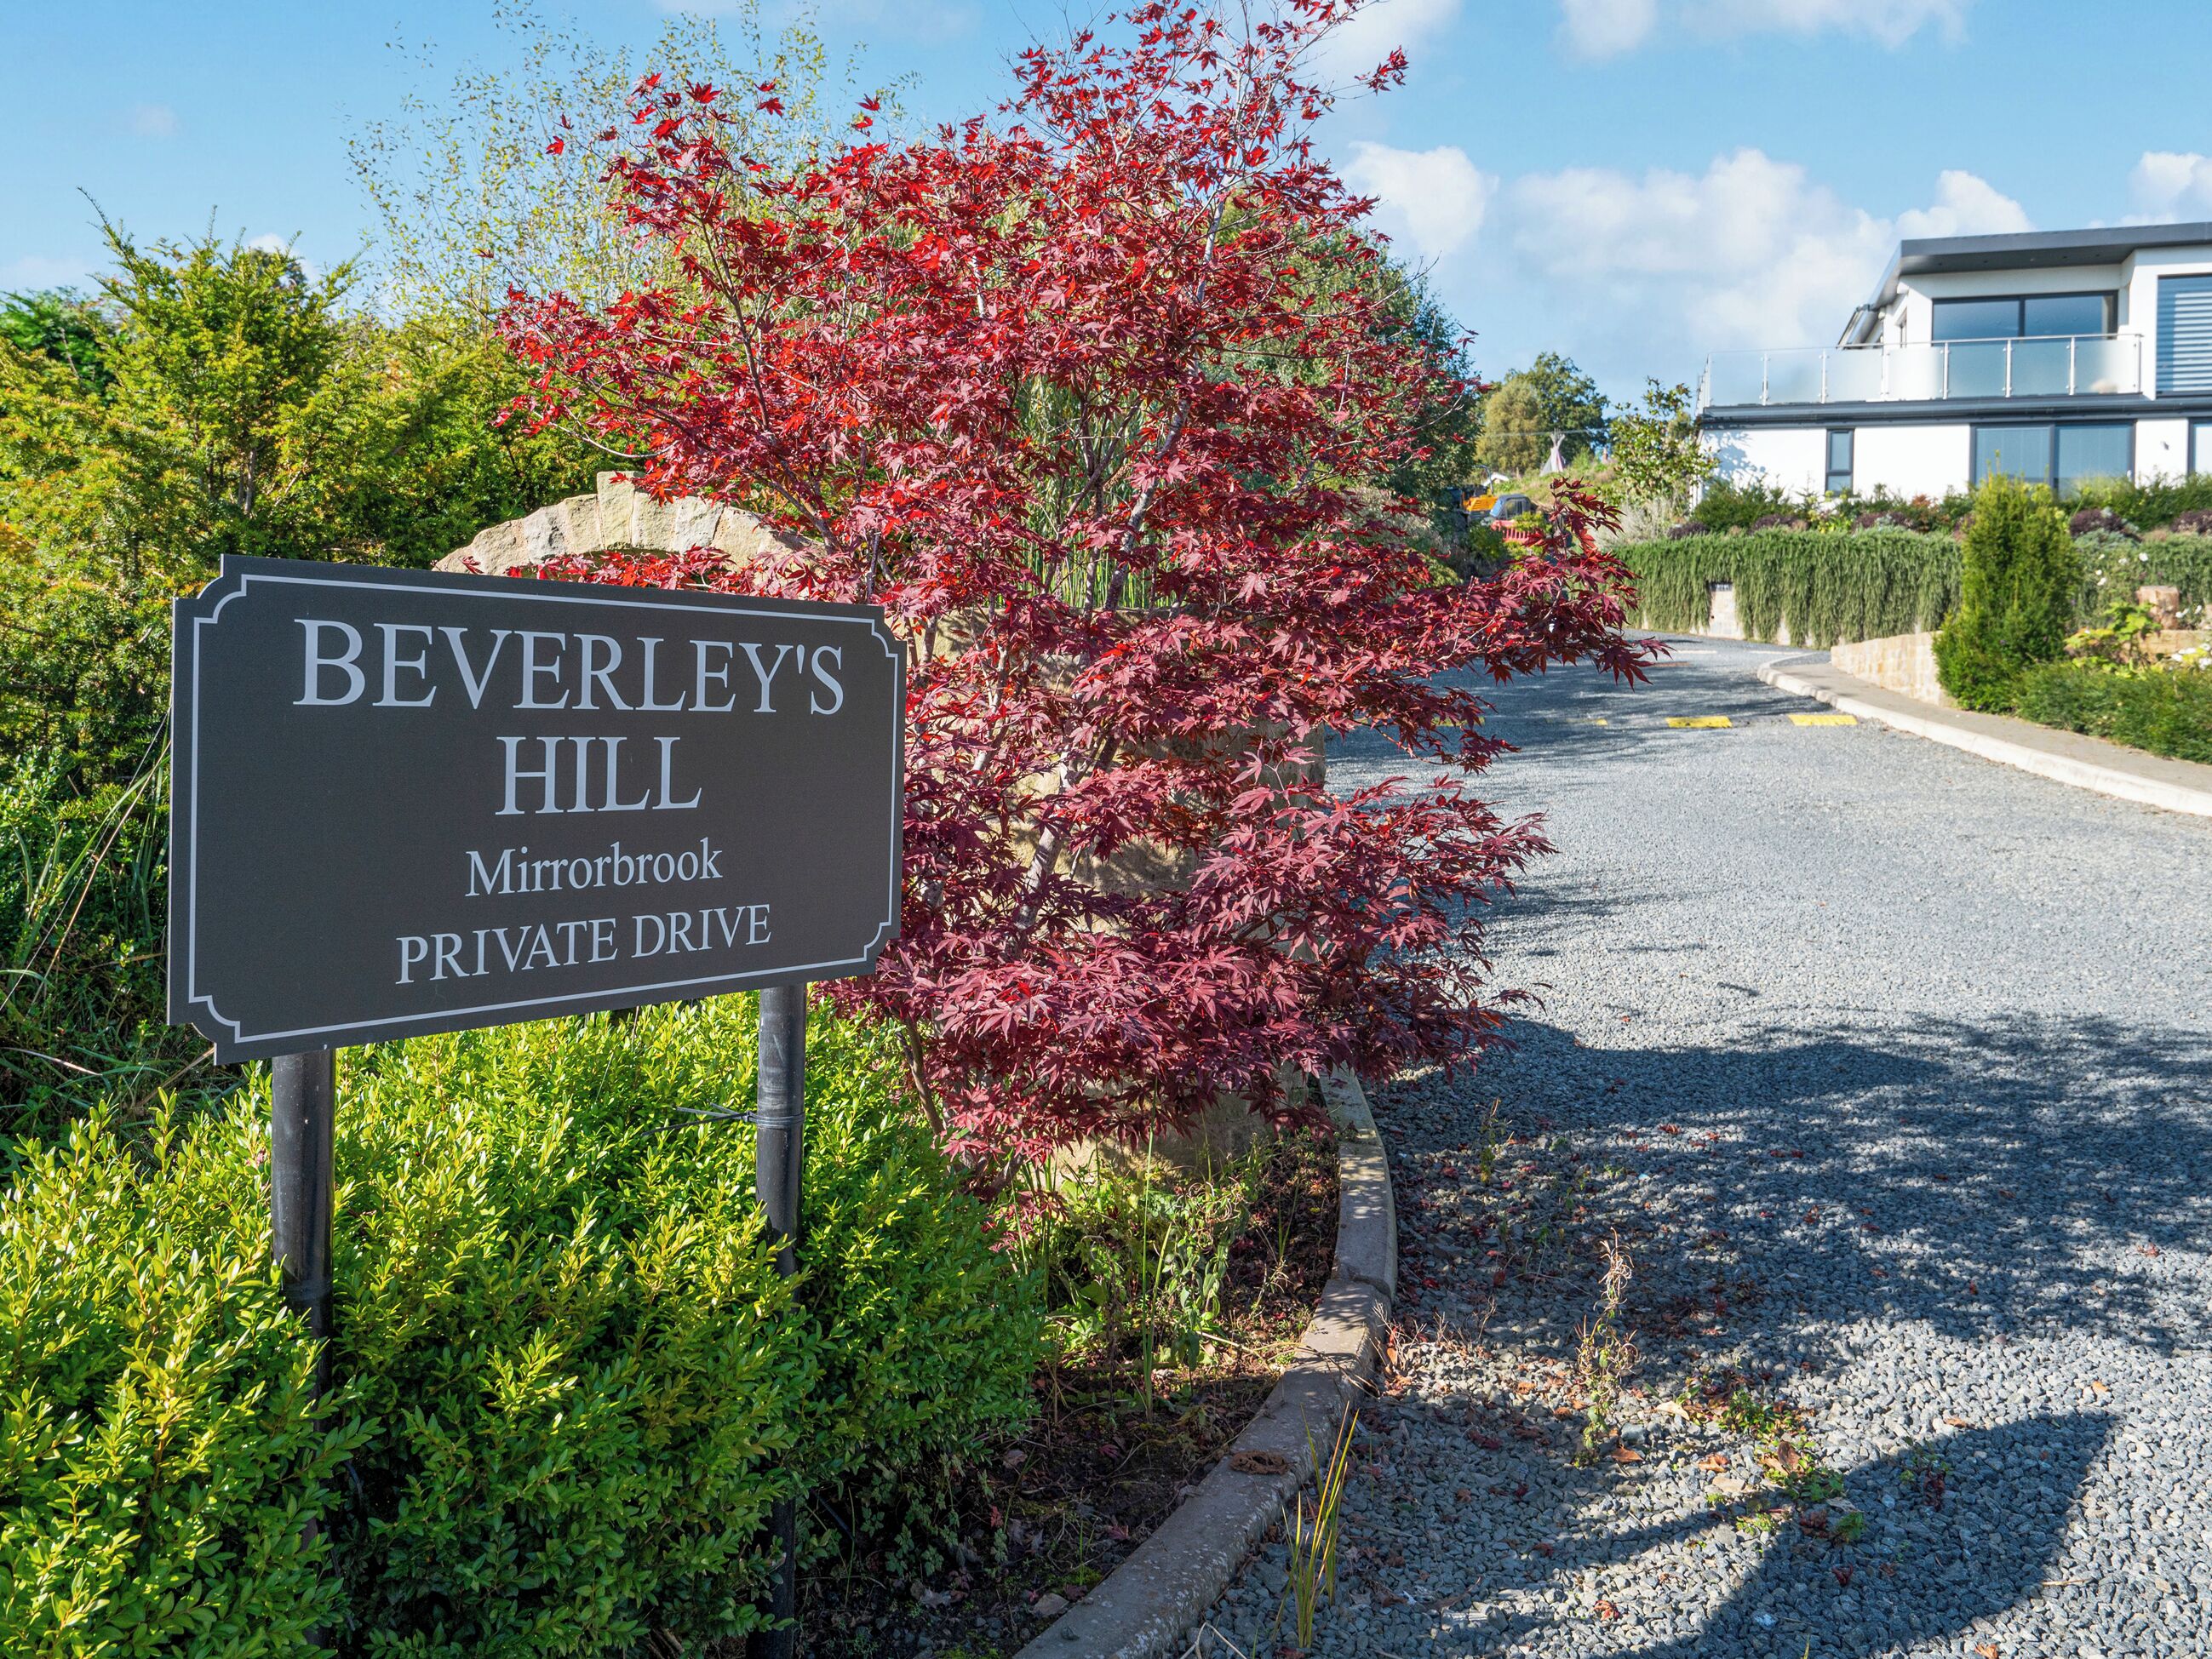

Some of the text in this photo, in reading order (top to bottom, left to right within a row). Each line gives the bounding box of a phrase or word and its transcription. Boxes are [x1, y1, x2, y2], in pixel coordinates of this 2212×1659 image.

[292, 619, 844, 715] BEVERLEY'S
[495, 736, 702, 815] HILL
[465, 837, 724, 896] Mirrorbrook
[395, 903, 771, 984] PRIVATE DRIVE
